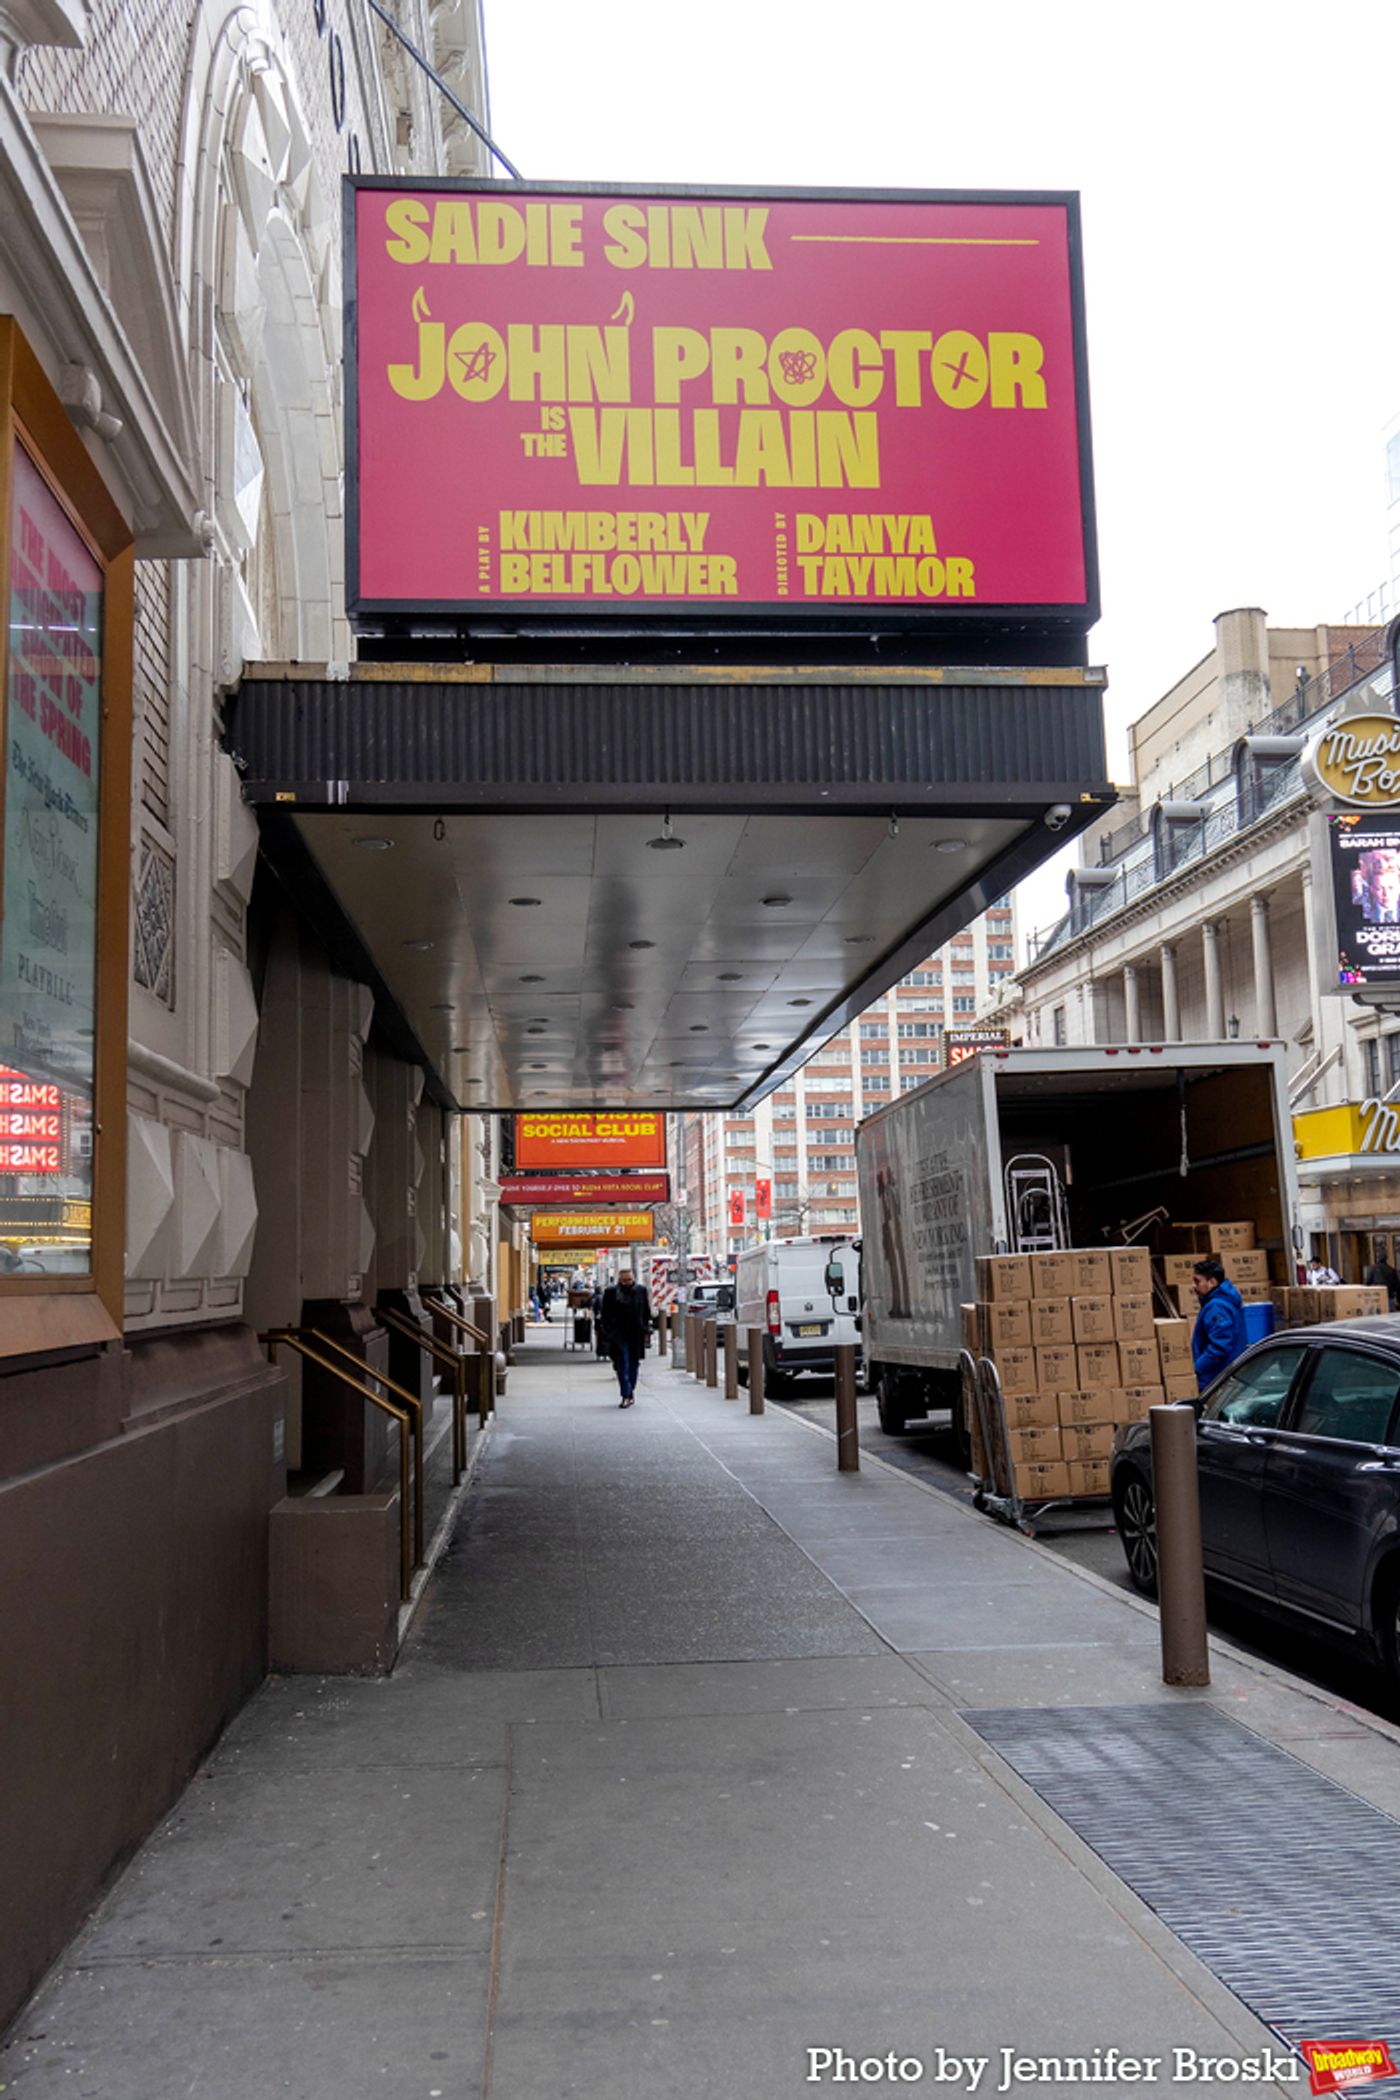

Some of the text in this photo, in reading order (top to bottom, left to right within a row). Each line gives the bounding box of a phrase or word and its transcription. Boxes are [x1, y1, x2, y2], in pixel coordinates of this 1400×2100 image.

[385, 199, 773, 269] SADIE SINK
[388, 321, 1048, 410] JOHN PROCTOR
[541, 406, 566, 431] IS
[520, 433, 567, 457] THE
[568, 407, 881, 489] VILLAIN
[20, 505, 44, 577] THE
[499, 510, 710, 552] KIMBERLY
[796, 513, 937, 554] DANYA
[477, 526, 491, 593] A PLAY BY
[499, 553, 738, 595] BELFLOWER
[774, 512, 789, 596] DIRECTED BY
[796, 556, 975, 597] TAYMOR
[39, 688, 91, 778] SPRING
[18, 952, 73, 1006] PLAYBILL
[522, 1122, 657, 1138] SOCIAL CLUB
[535, 1215, 650, 1226] PERFORMANCES BEGIN
[558, 1226, 611, 1236] FEBRUARY
